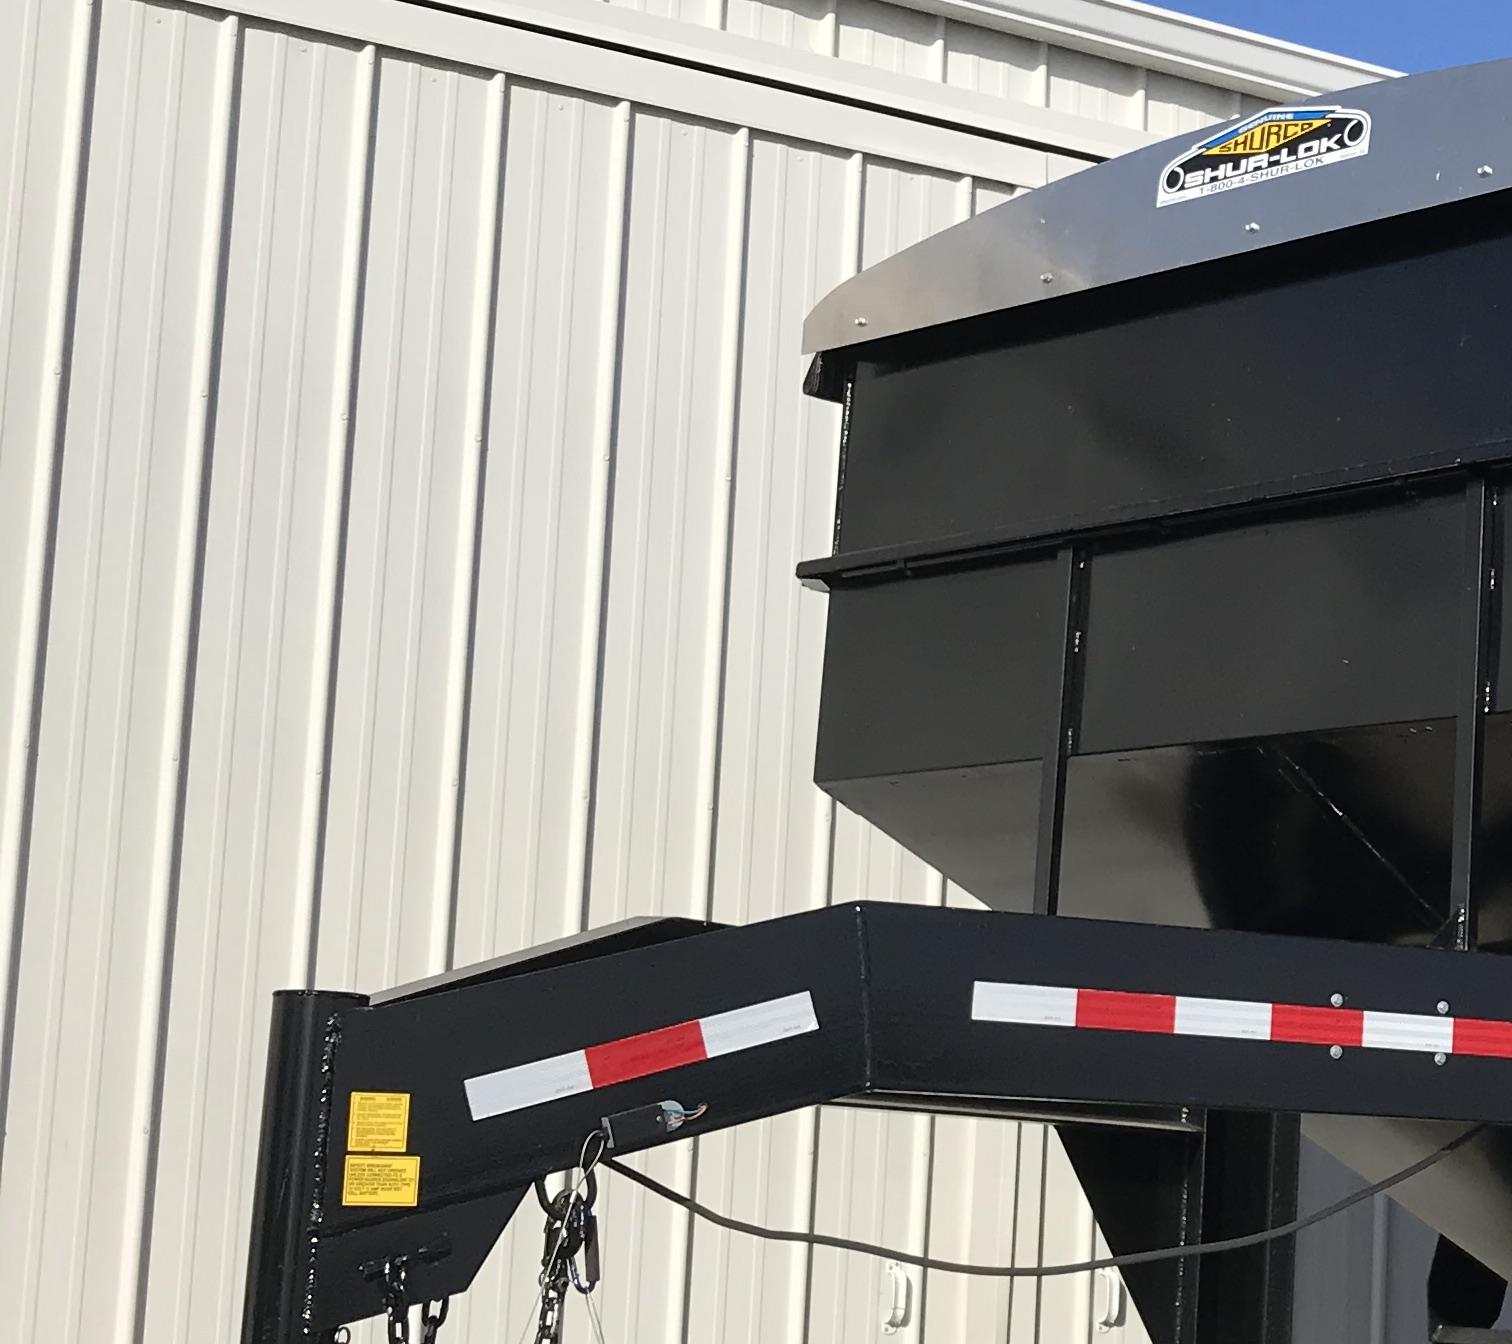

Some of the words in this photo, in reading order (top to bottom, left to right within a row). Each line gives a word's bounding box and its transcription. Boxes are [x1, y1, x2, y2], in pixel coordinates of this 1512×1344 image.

[1218, 122, 1314, 153] SHURCO
[1184, 133, 1342, 188] SHUR-LOK
[1198, 156, 1324, 195] 1-800-4-SHUR-LOK
